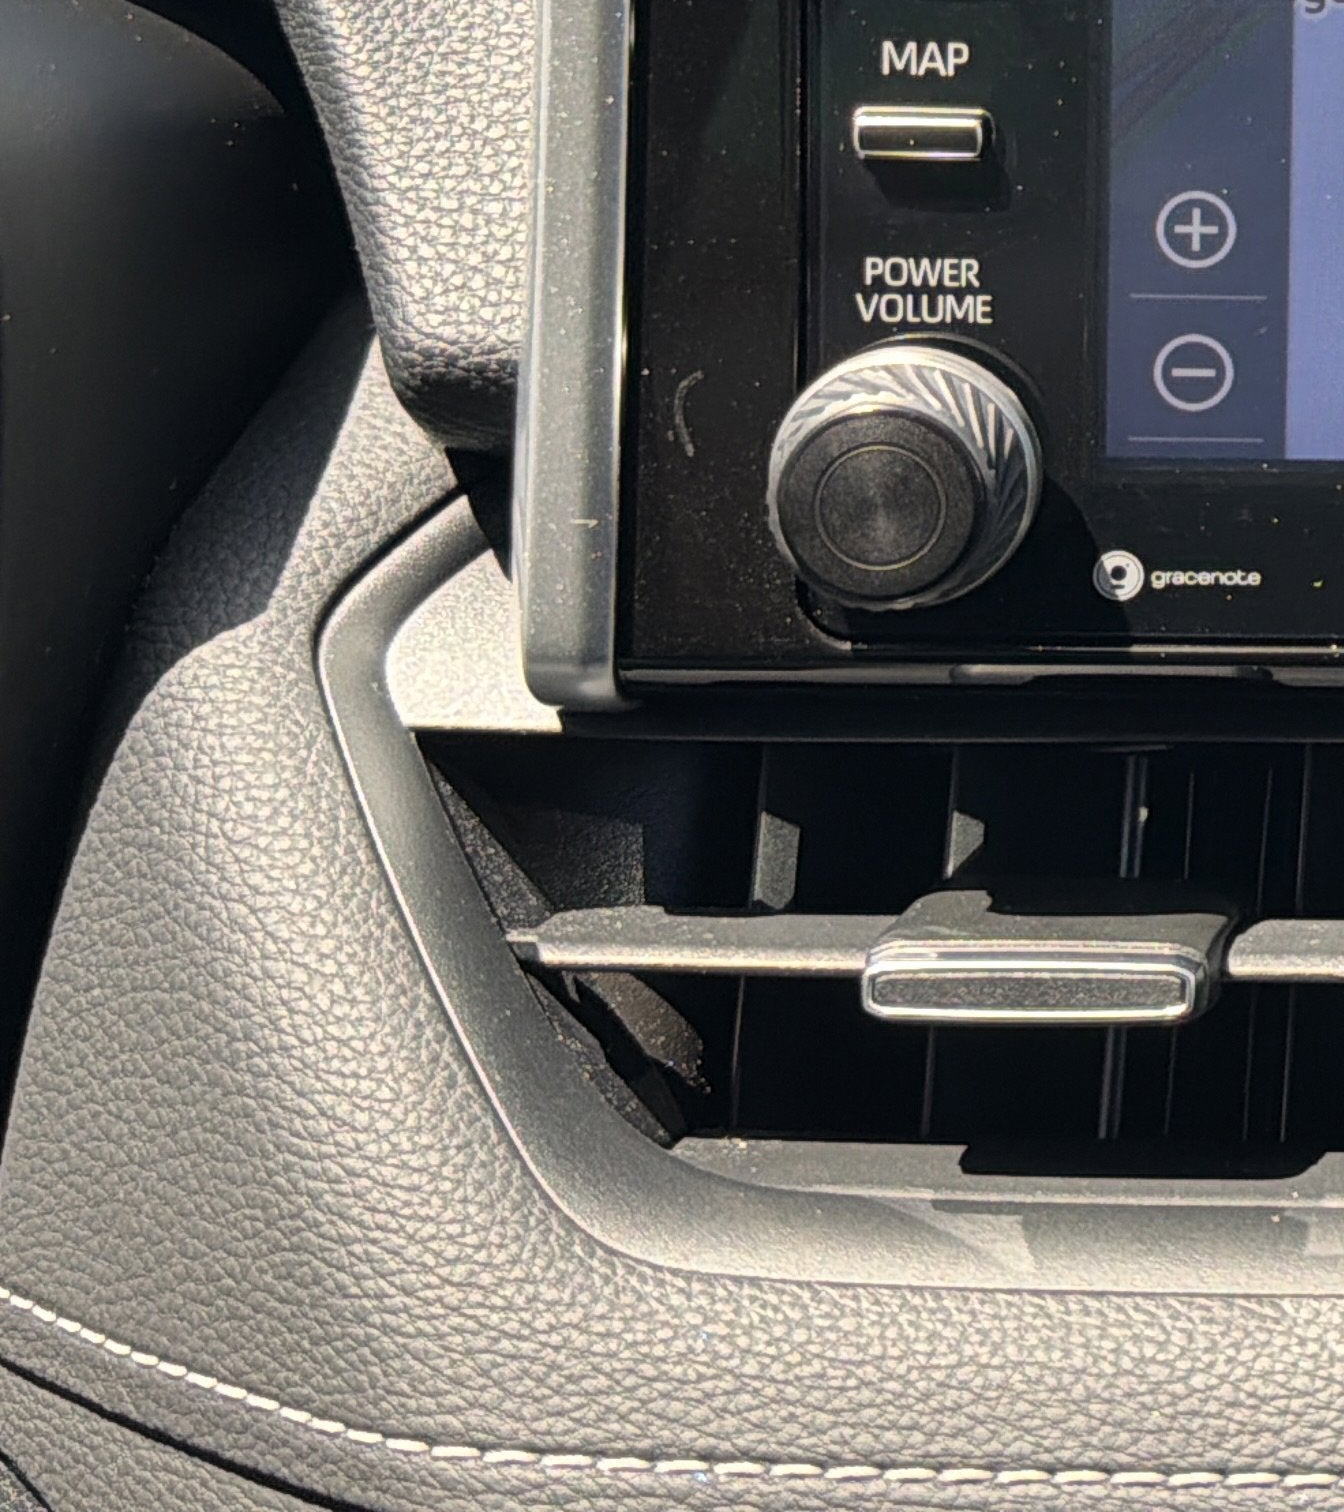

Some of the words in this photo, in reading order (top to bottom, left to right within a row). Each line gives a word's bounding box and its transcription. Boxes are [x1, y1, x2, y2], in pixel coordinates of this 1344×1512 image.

[881, 40, 970, 77] MAP
[864, 256, 980, 288] POWER
[855, 292, 993, 324] VOLUME
[1150, 569, 1262, 590] gracenote
